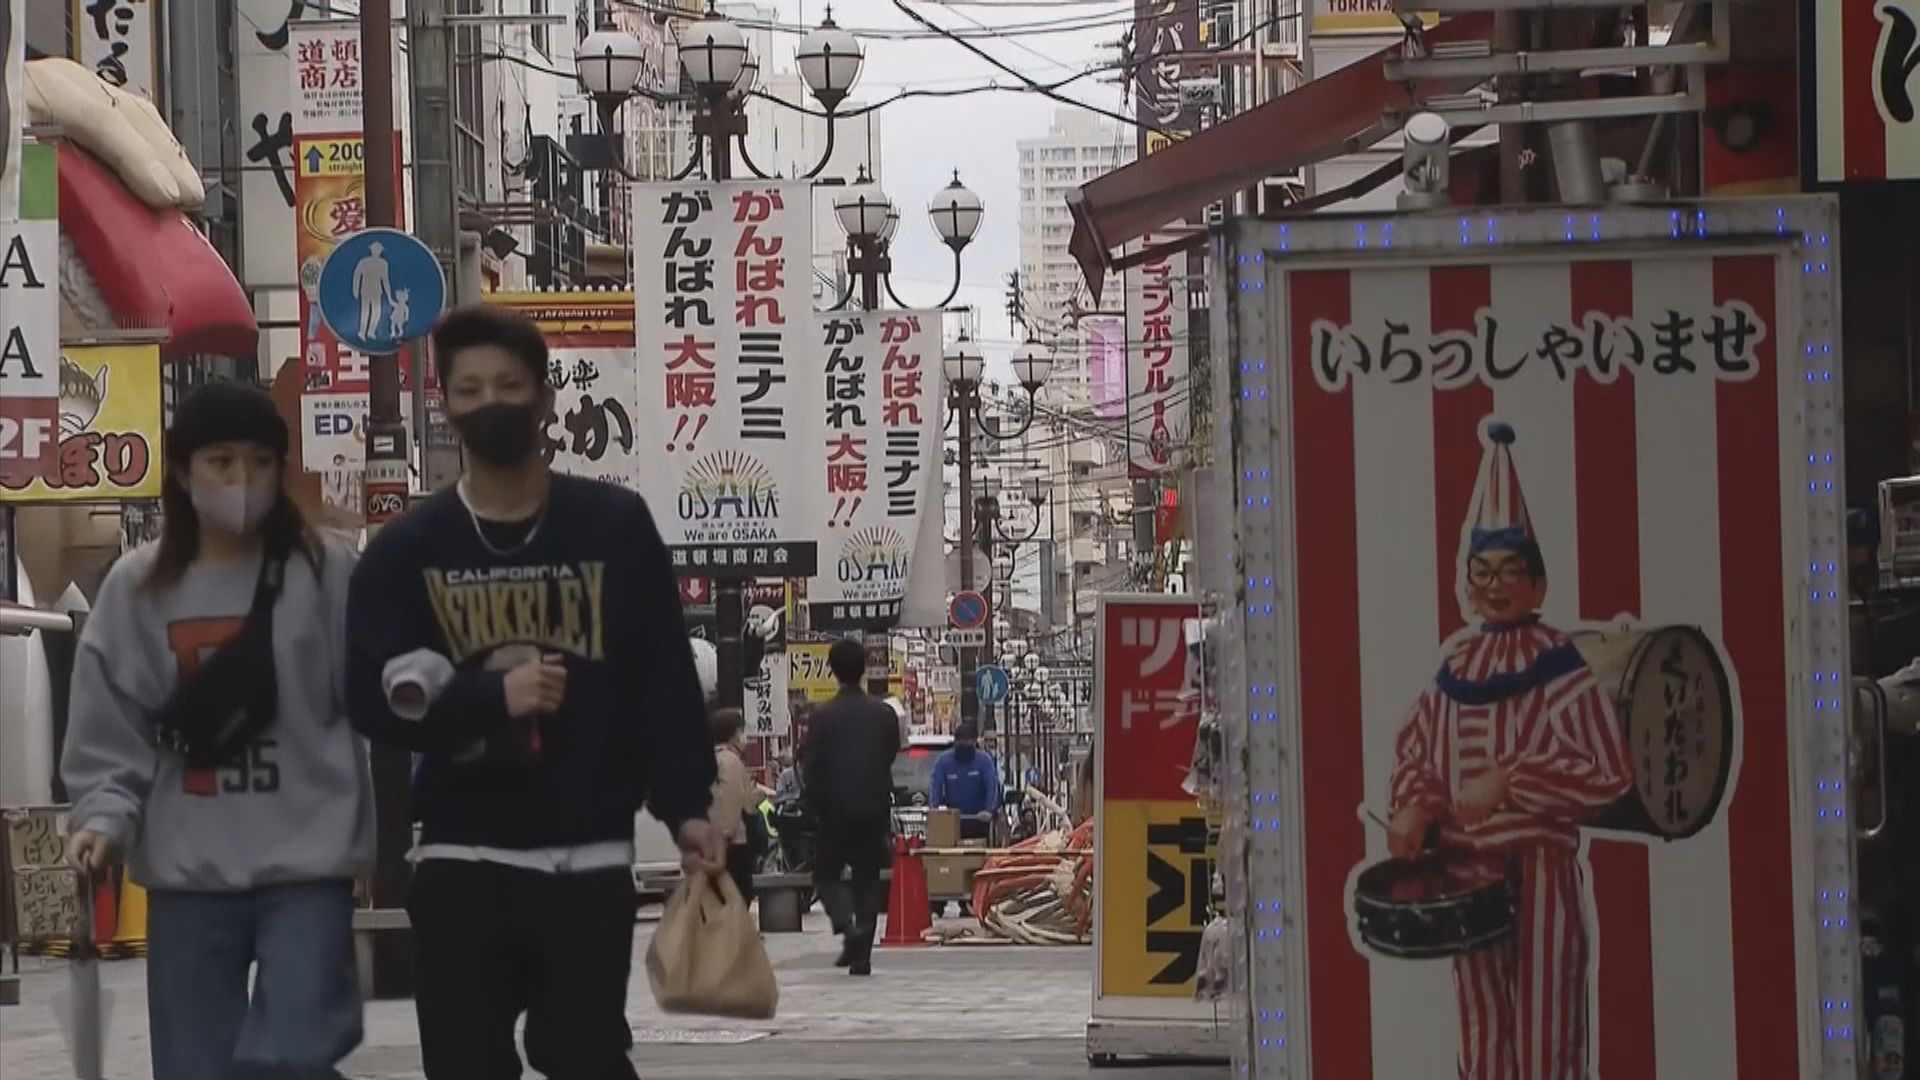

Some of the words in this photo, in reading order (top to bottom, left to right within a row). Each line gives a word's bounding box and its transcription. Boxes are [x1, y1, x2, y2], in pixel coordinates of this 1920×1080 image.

[732, 189, 787, 441] がんばれミナミ
[1318, 308, 1757, 384] いらっしゃいませ
[0, 418, 51, 458] 2F
[879, 316, 923, 517] がんばれミナミ
[678, 476, 780, 520] OSAKA
[685, 530, 705, 541] We
[708, 531, 728, 541] are
[732, 528, 777, 541] OSAKA
[446, 564, 574, 584] CALIFORNIA
